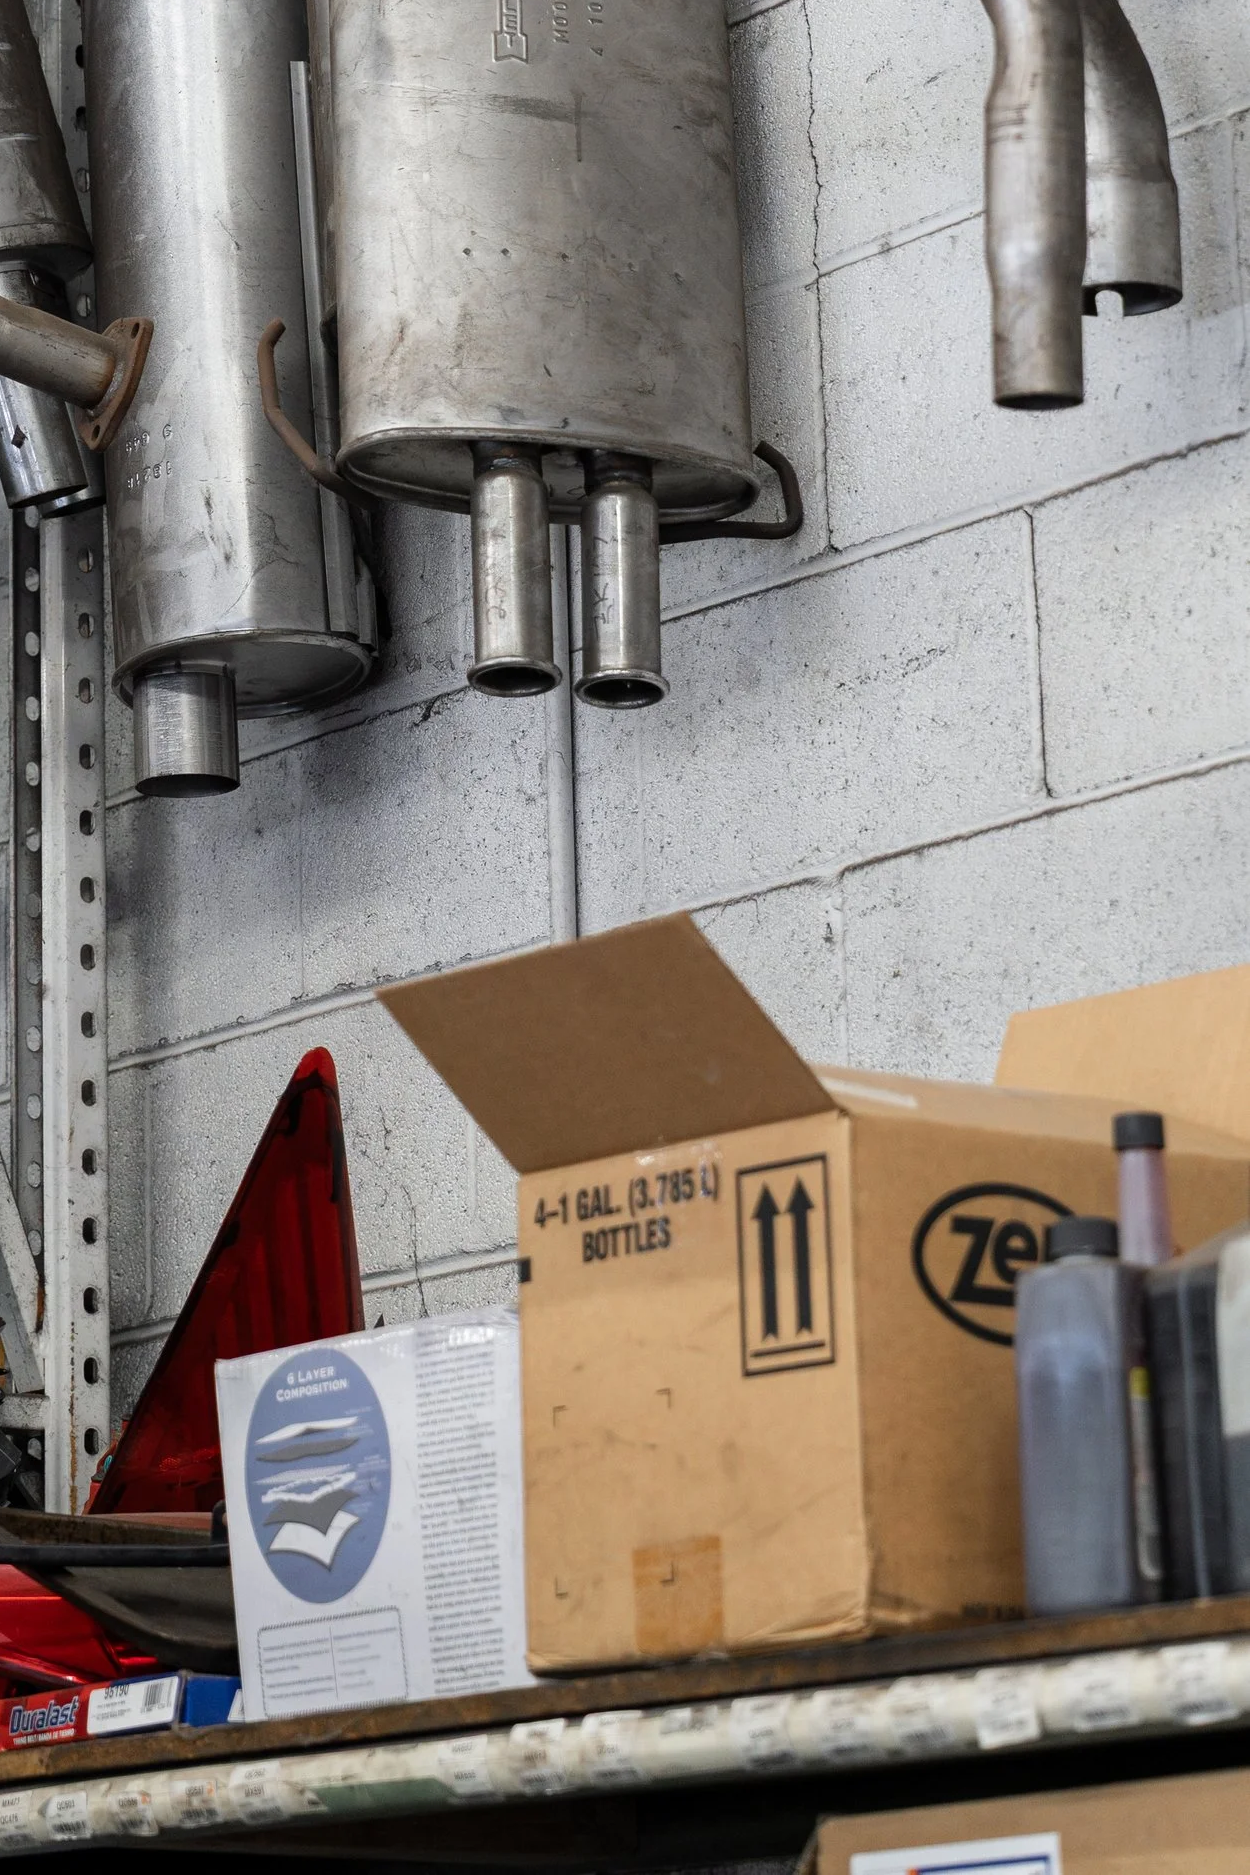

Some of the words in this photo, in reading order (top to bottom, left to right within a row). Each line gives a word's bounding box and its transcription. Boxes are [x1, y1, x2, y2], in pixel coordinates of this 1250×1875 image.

[575, 1184, 623, 1222] GAL.
[627, 1168, 695, 1218] (3.785
[582, 1215, 672, 1263] BOTTLES
[949, 1214, 1053, 1307] Ze
[275, 1378, 349, 1402] COMPOSITION
[297, 1365, 336, 1384] LAYER
[9, 1695, 79, 1736] Duralast
